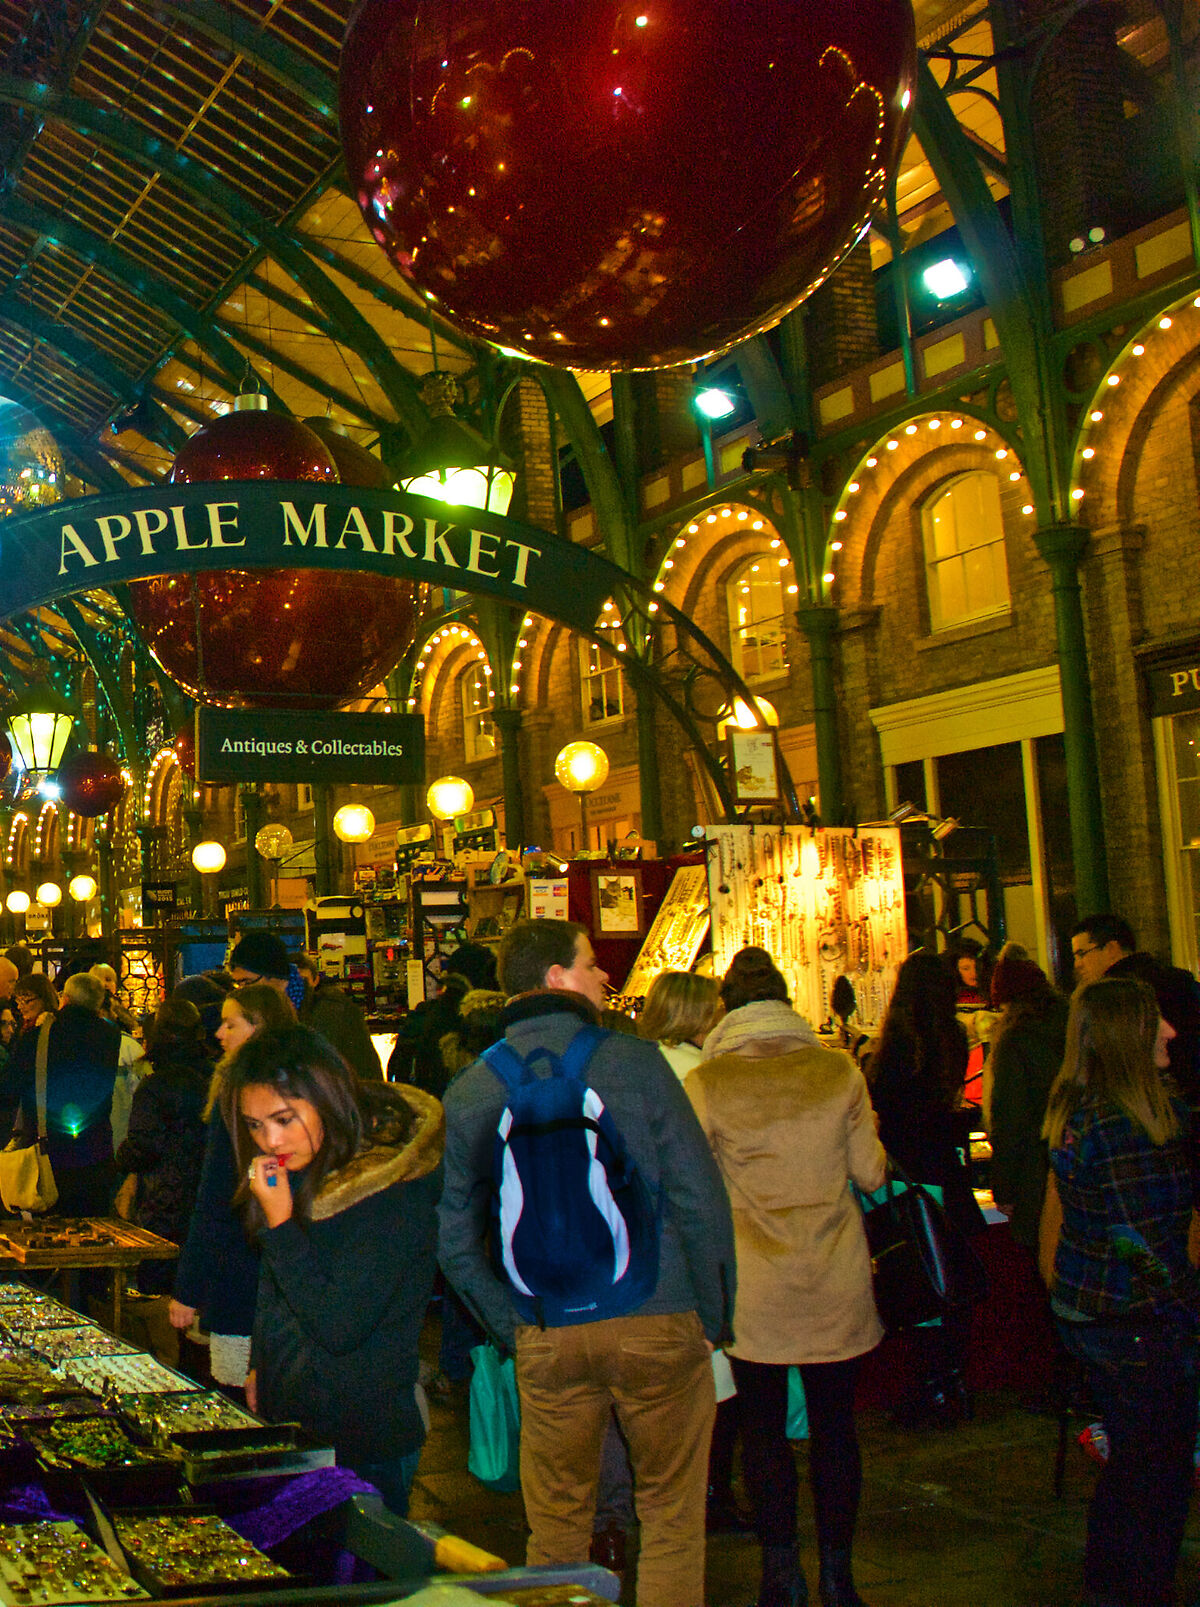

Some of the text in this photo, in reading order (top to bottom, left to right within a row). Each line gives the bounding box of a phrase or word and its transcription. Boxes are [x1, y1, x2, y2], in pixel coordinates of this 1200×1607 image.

[58, 501, 542, 588] APPLE MARKET
[220, 737, 403, 757] Antiques & Collectables
